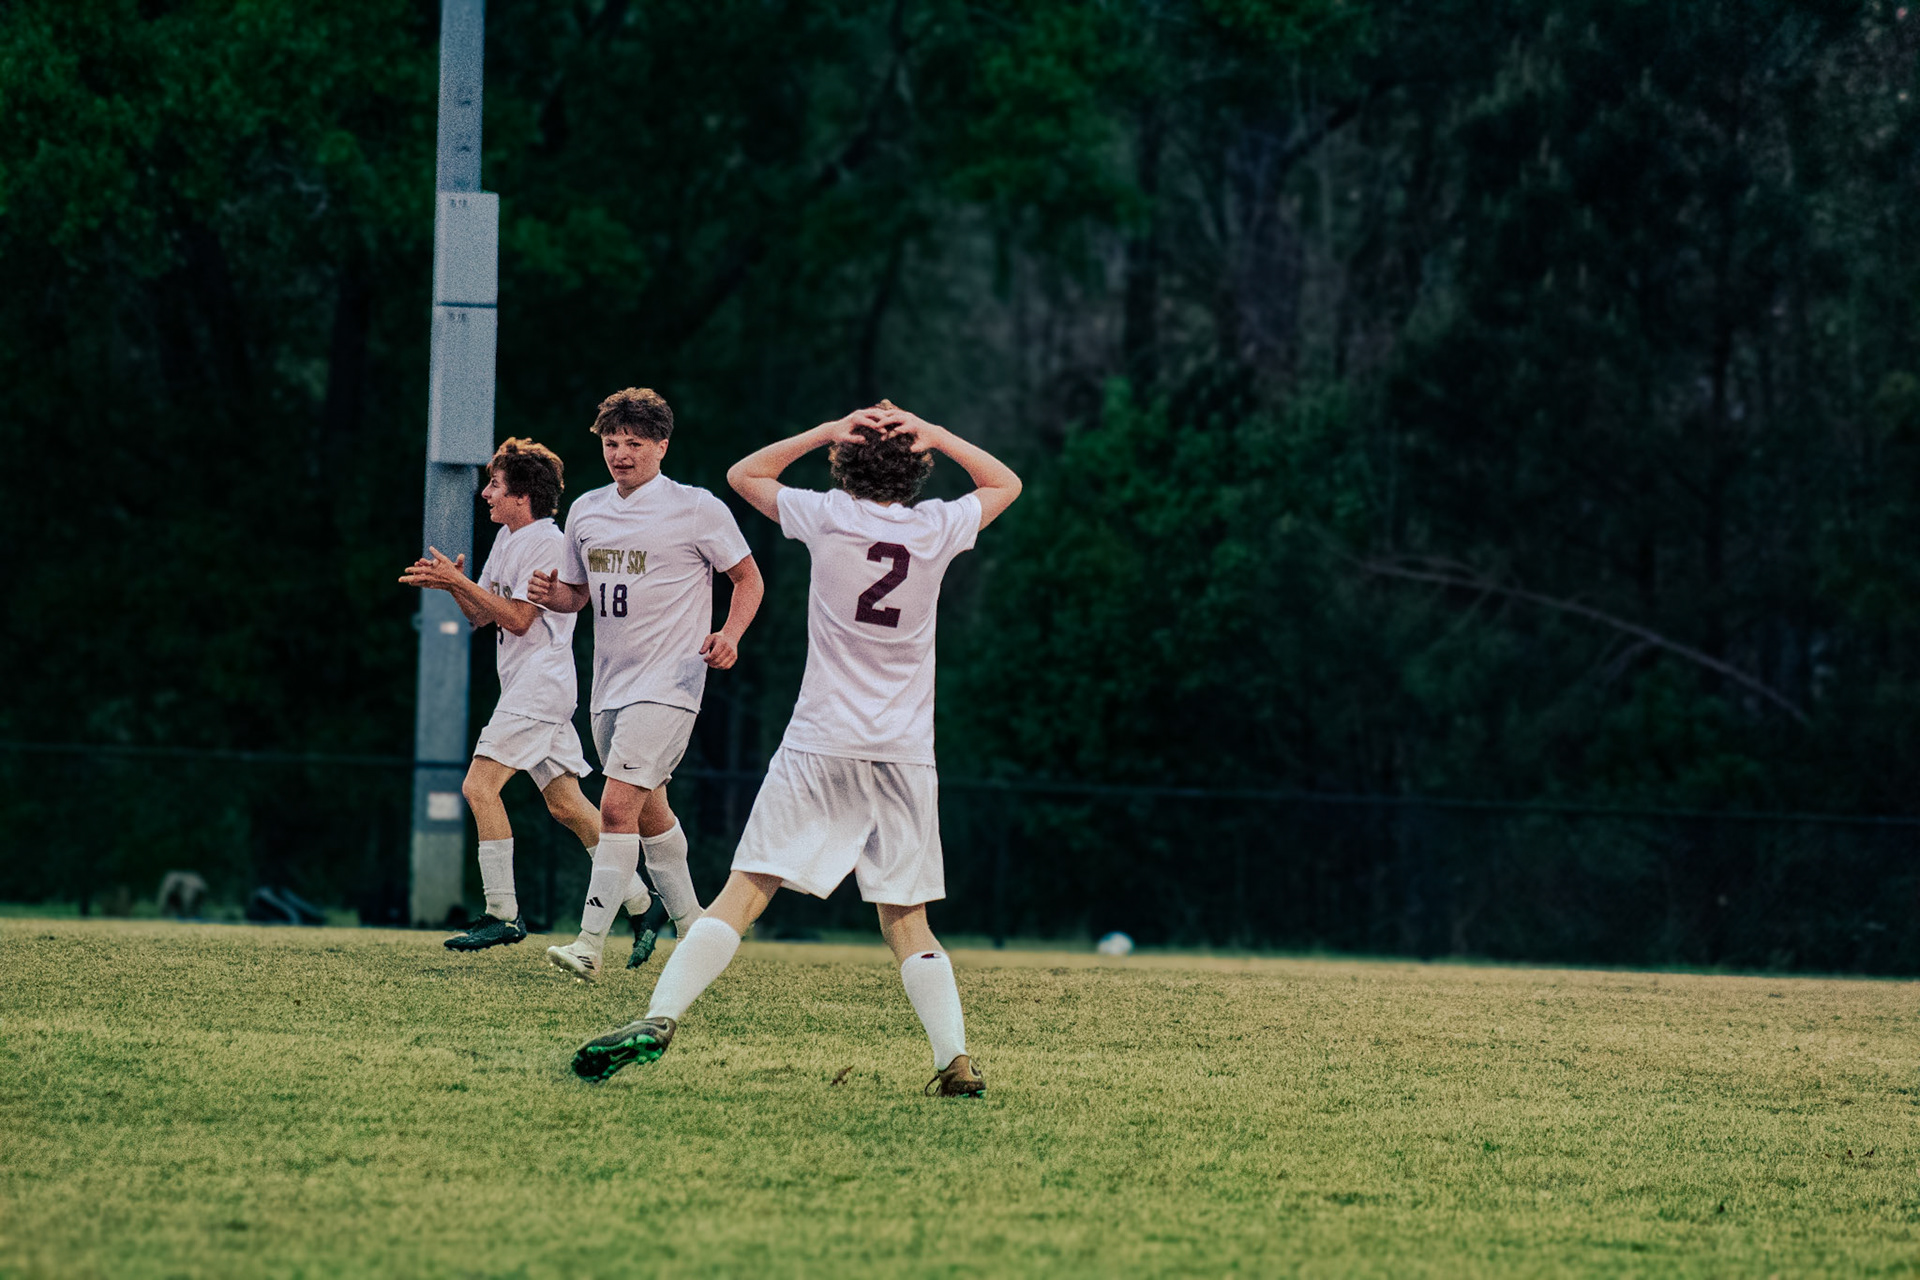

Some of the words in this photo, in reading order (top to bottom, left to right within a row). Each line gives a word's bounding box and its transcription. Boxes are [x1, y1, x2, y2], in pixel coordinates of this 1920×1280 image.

[627, 550, 647, 575] SIX
[599, 582, 628, 617] 18
[855, 541, 911, 628] 2
